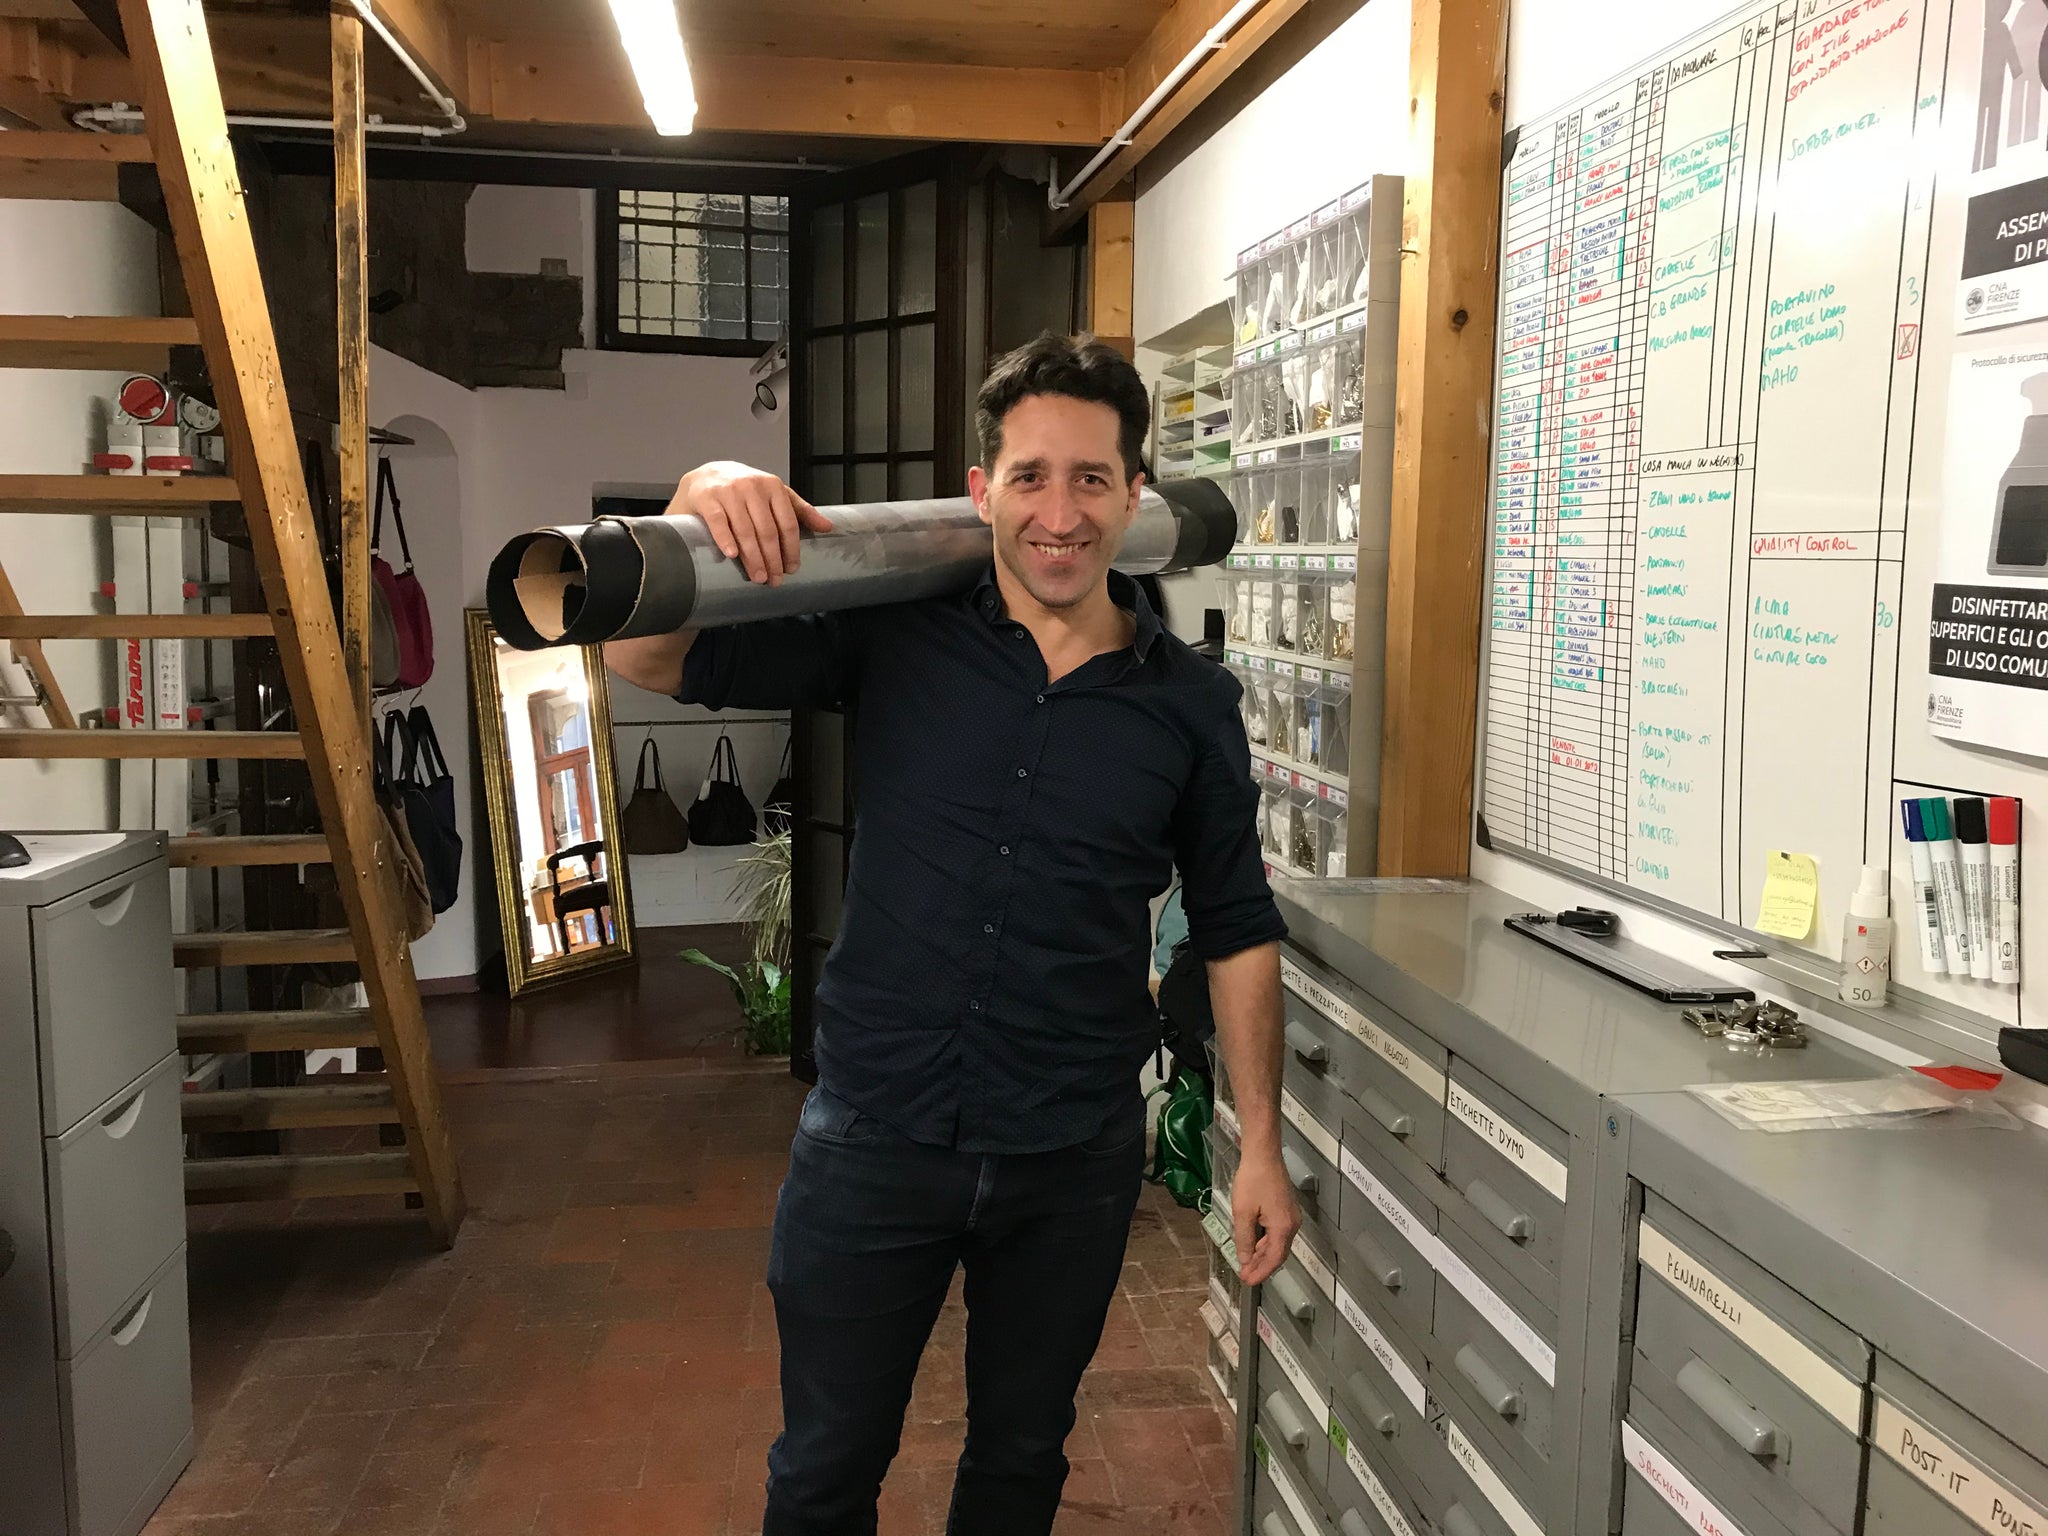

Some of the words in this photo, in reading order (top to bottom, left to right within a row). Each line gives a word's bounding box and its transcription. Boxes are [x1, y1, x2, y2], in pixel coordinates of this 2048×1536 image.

[1791, 54, 1814, 76] CON
[2014, 241, 2033, 263] DI
[1670, 281, 1708, 310] GRANDE
[1770, 283, 1835, 318] PORTAVINO
[1987, 289, 2020, 304] FIRENZE
[1989, 282, 2008, 293] CNA
[1971, 354, 2007, 368] Protocollo
[2008, 353, 2016, 364] di
[2017, 351, 2048, 364] sicurezz
[1642, 460, 1662, 473] COSA
[1667, 459, 1692, 470] MANCA
[1754, 535, 1800, 555] QUALITY
[1806, 536, 1858, 552] CONTROL
[1951, 596, 2048, 621] DISINFETTAR
[1930, 620, 1995, 643] SUPERFICI
[1998, 627, 2007, 645] E
[2009, 629, 2033, 648] GLI
[1946, 649, 1961, 667] DI
[1964, 651, 1997, 671] USO
[2000, 655, 2048, 678] COMU
[1937, 705, 1964, 718] FIRENZE
[1938, 695, 1953, 705] CNA
[1310, 987, 1348, 1023] PREZZATRICE
[1852, 987, 1872, 1002] 50
[1358, 1019, 1377, 1046] GANCI
[1384, 1040, 1409, 1069] NEGOZIO
[1450, 1091, 1494, 1137] ETICHETTE
[1499, 1128, 1525, 1160] DYMO
[1377, 1193, 1410, 1234] ACCESSORI
[1667, 1252, 1741, 1325] PENNARELLI
[1344, 1299, 1368, 1337] ATTREZZI
[1348, 1447, 1370, 1485] OTTONE
[1451, 1433, 1478, 1473] NICKEL
[1639, 1450, 1689, 1510] SACCHETTI
